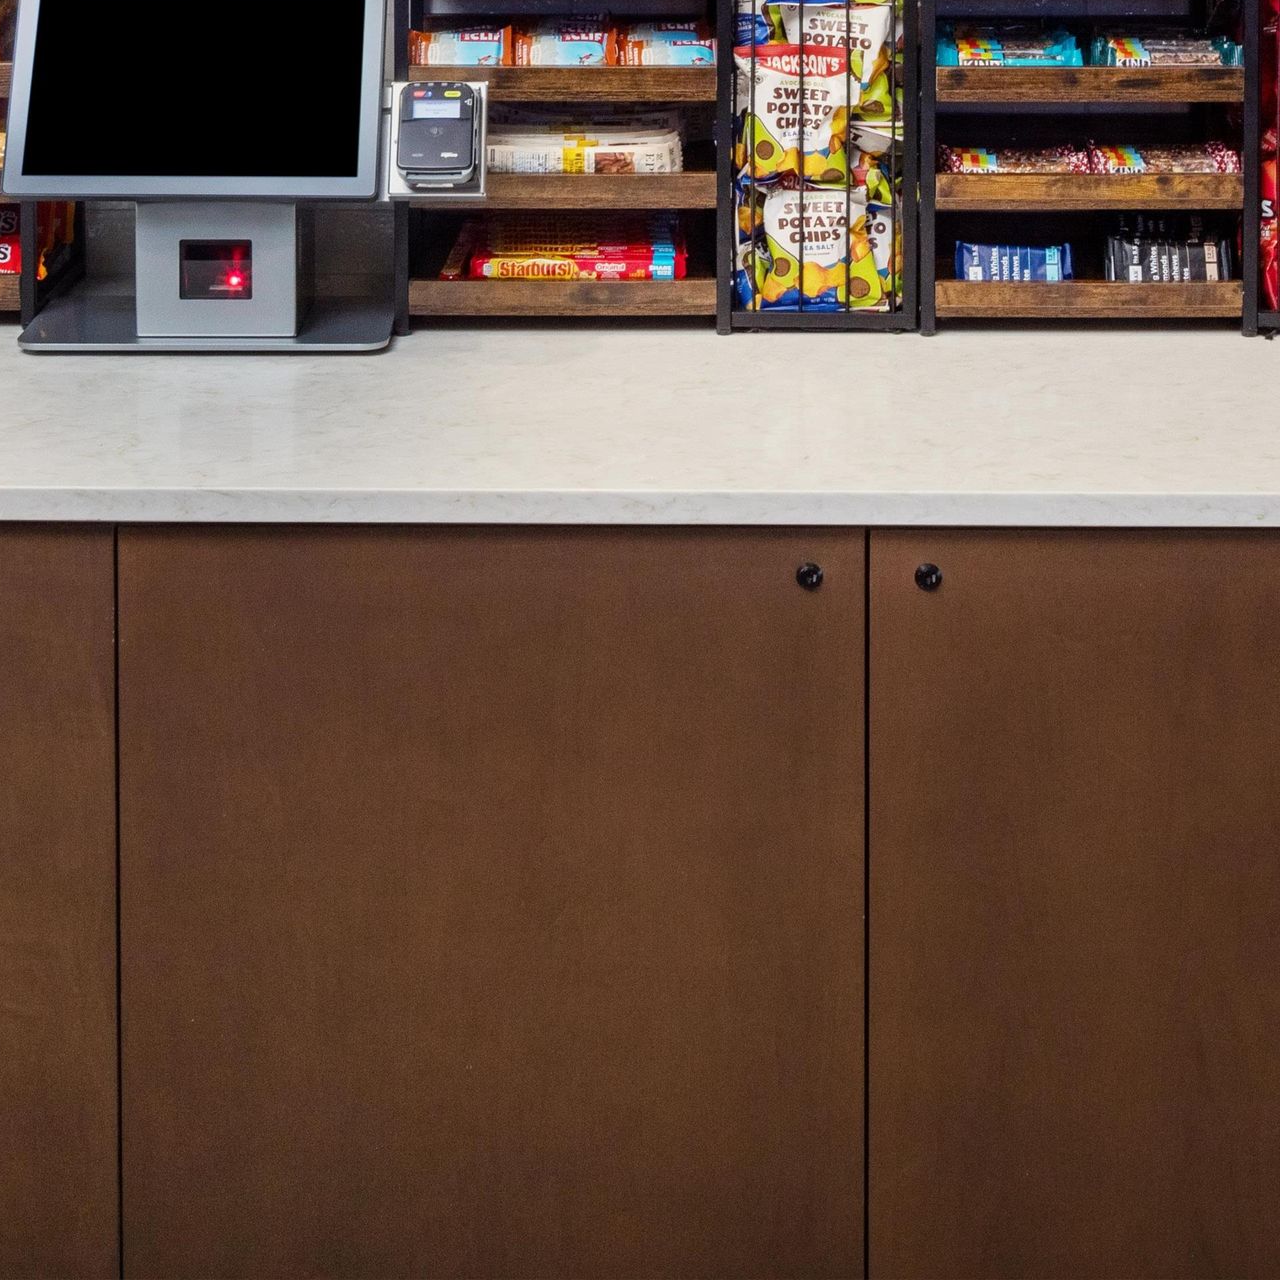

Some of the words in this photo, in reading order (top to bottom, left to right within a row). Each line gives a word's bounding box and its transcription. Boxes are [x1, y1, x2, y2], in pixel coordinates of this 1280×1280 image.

[808, 18, 869, 35] SWEET
[802, 34, 872, 48] POTATO
[765, 54, 840, 74] JACKSON'S
[1116, 59, 1151, 67] KIND
[773, 87, 830, 101] SWEET
[767, 102, 833, 117] POTATO
[783, 202, 844, 214] SWEET
[778, 215, 848, 229] POTATO
[789, 229, 841, 243] CHIPS
[595, 263, 626, 271] Original
[990, 248, 998, 274] Whites
[1150, 246, 1158, 274] Whites
[498, 260, 573, 277] Starburst
